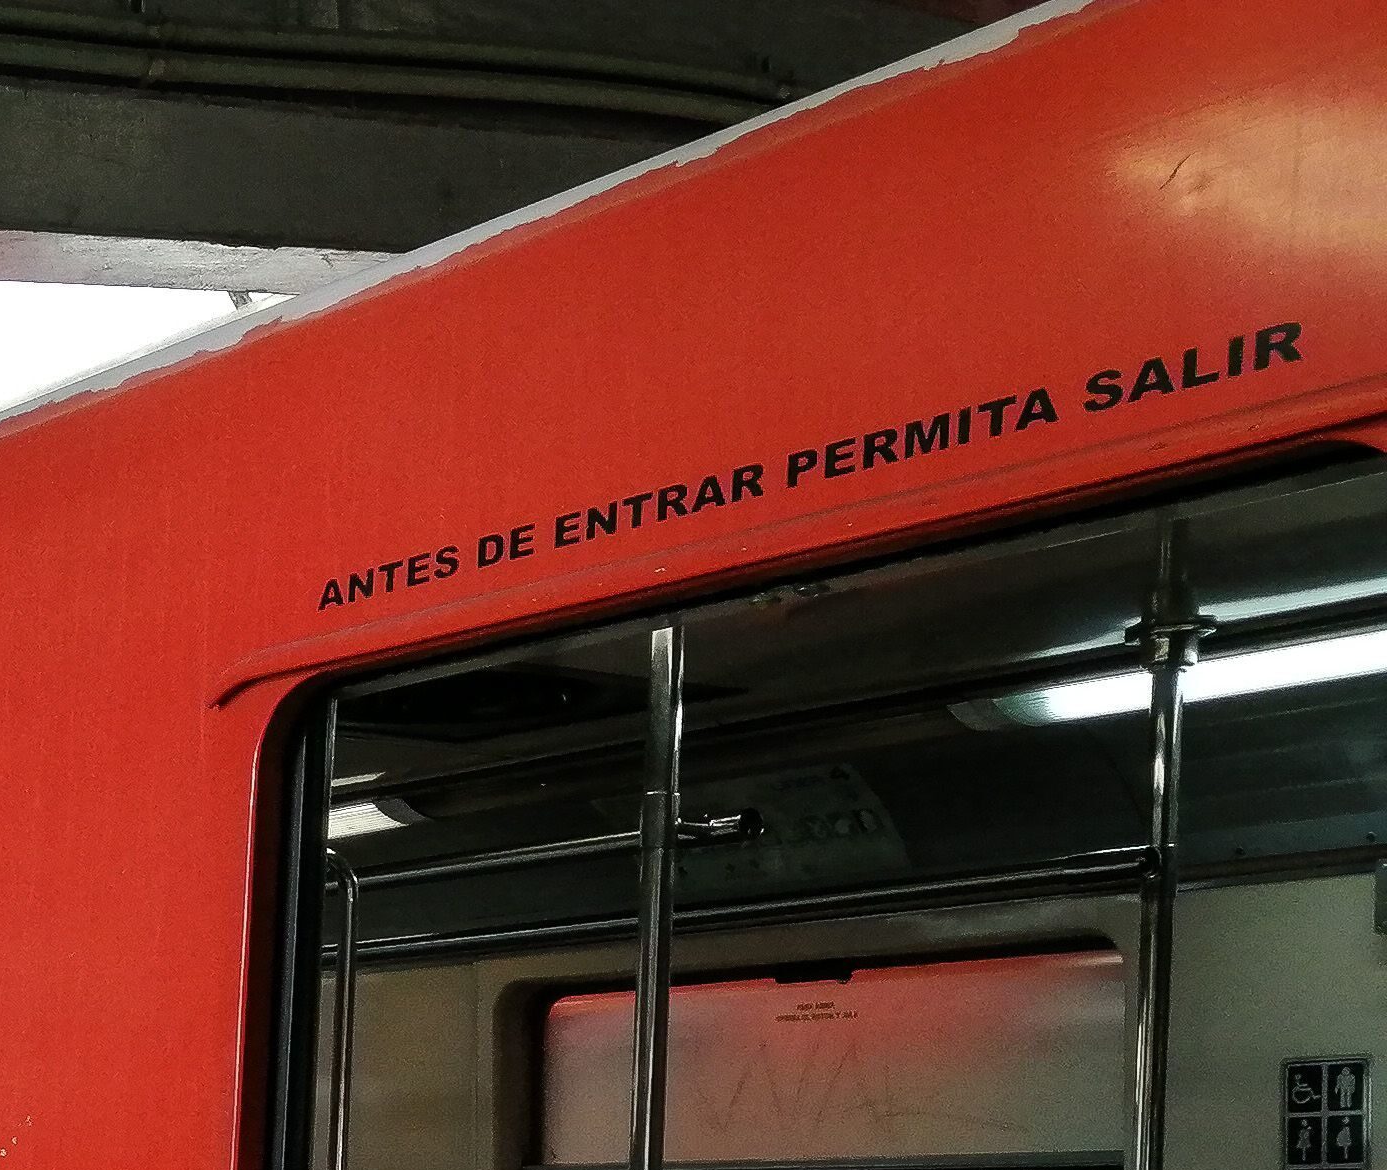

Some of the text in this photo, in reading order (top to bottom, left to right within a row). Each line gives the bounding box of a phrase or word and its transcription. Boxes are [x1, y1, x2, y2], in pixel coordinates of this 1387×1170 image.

[317, 321, 1304, 612] ANTES DE ENTRAR PERMITA SALIR
